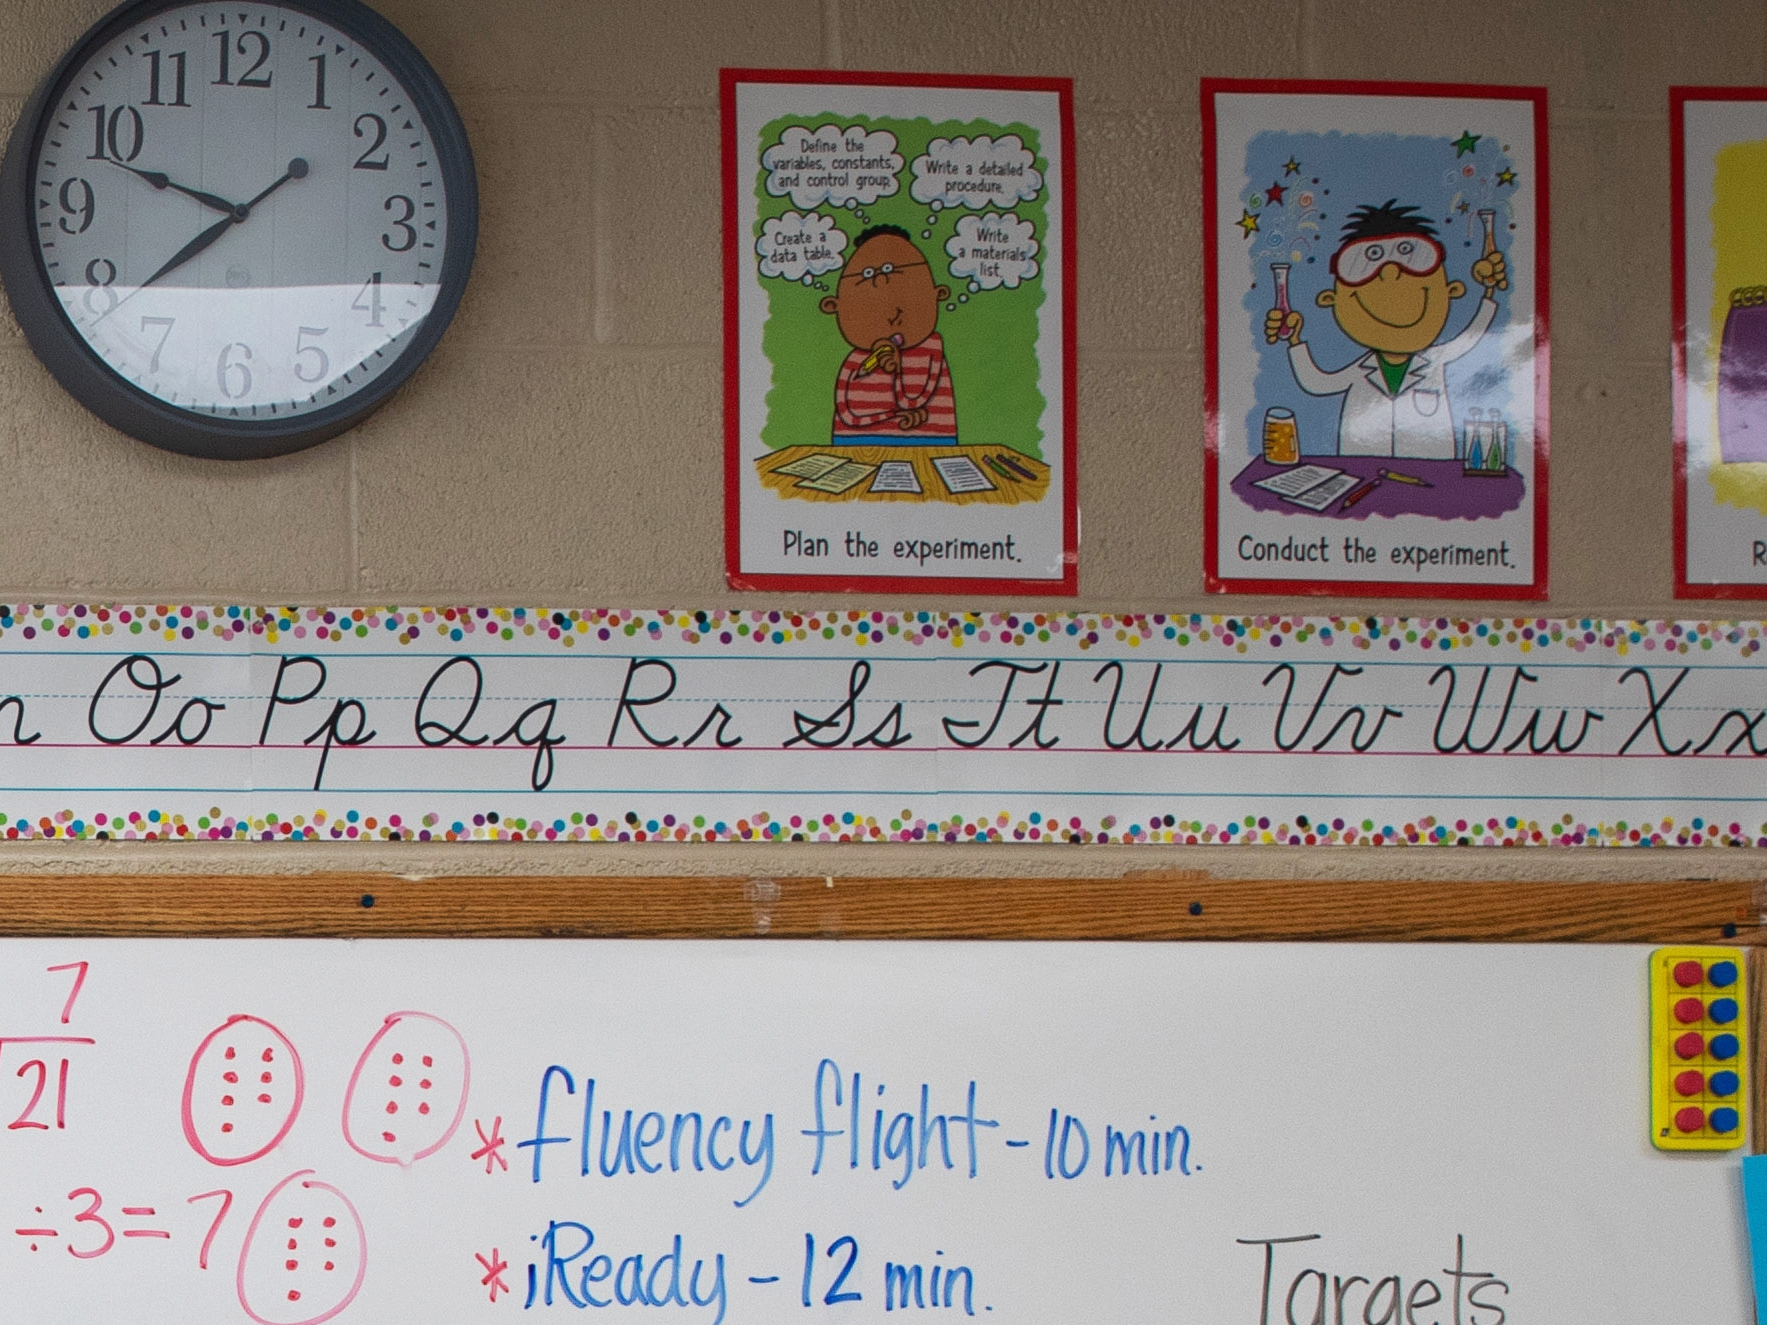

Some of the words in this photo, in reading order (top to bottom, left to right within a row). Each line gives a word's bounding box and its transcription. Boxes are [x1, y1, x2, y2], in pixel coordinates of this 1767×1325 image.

[211, 30, 274, 88] 12
[87, 105, 144, 162] 10
[353, 113, 389, 171] 2
[801, 139, 837, 152] Define
[845, 140, 864, 152] the
[773, 158, 825, 171] variables,
[832, 158, 894, 170] constants,
[778, 175, 799, 187] and
[807, 173, 848, 187] control
[926, 160, 959, 173] Write
[966, 165, 972, 174] a
[979, 162, 1023, 176] detailed
[58, 177, 95, 234] 9
[381, 195, 417, 251] 3
[771, 250, 798, 263] data
[775, 232, 811, 245] Create
[819, 234, 826, 242] a
[959, 249, 965, 258] a
[972, 248, 1027, 261] materials
[977, 229, 1008, 243] Write
[217, 343, 253, 400] 6
[782, 530, 830, 558] Plan
[845, 531, 878, 559] the
[892, 533, 1022, 567] experiment.
[1238, 534, 1329, 564] Conduct
[1343, 537, 1377, 565] the
[1389, 538, 1516, 572] experiment.
[88, 653, 227, 746] Oo
[259, 654, 378, 793] Pp
[1094, 662, 1242, 752] Uu
[1428, 664, 1604, 756] Ww
[46, 960, 92, 1026] 7
[514, 1061, 777, 1209] fluency
[884, 1238, 995, 1313] min.
